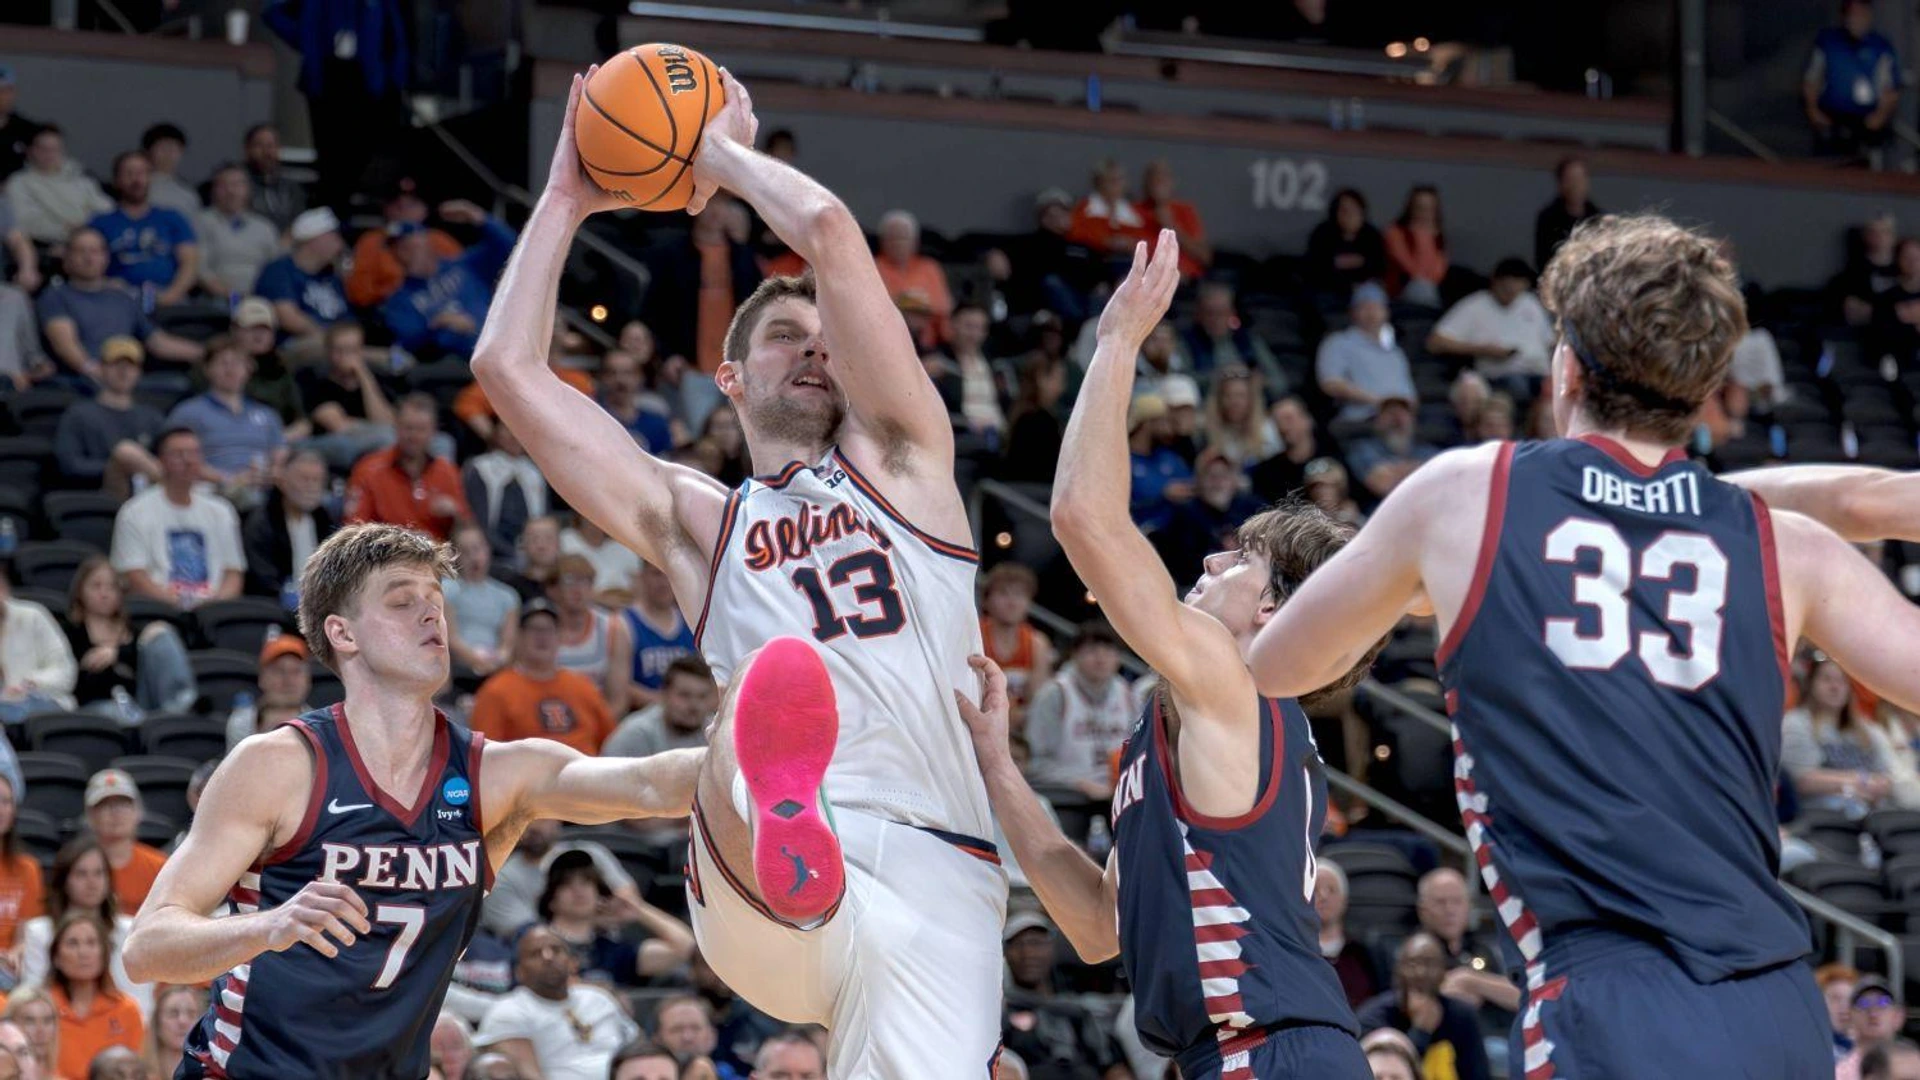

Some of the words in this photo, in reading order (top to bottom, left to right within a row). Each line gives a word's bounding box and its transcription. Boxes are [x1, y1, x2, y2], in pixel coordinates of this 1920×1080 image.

[1248, 159, 1328, 211] 102
[1581, 465, 1701, 516] OBERTI
[791, 548, 907, 643] 13
[1544, 517, 1729, 692] 33
[436, 809, 454, 821] Ivy
[446, 789, 469, 799] NCAA
[316, 840, 480, 890] PENN
[370, 903, 426, 991] 7
